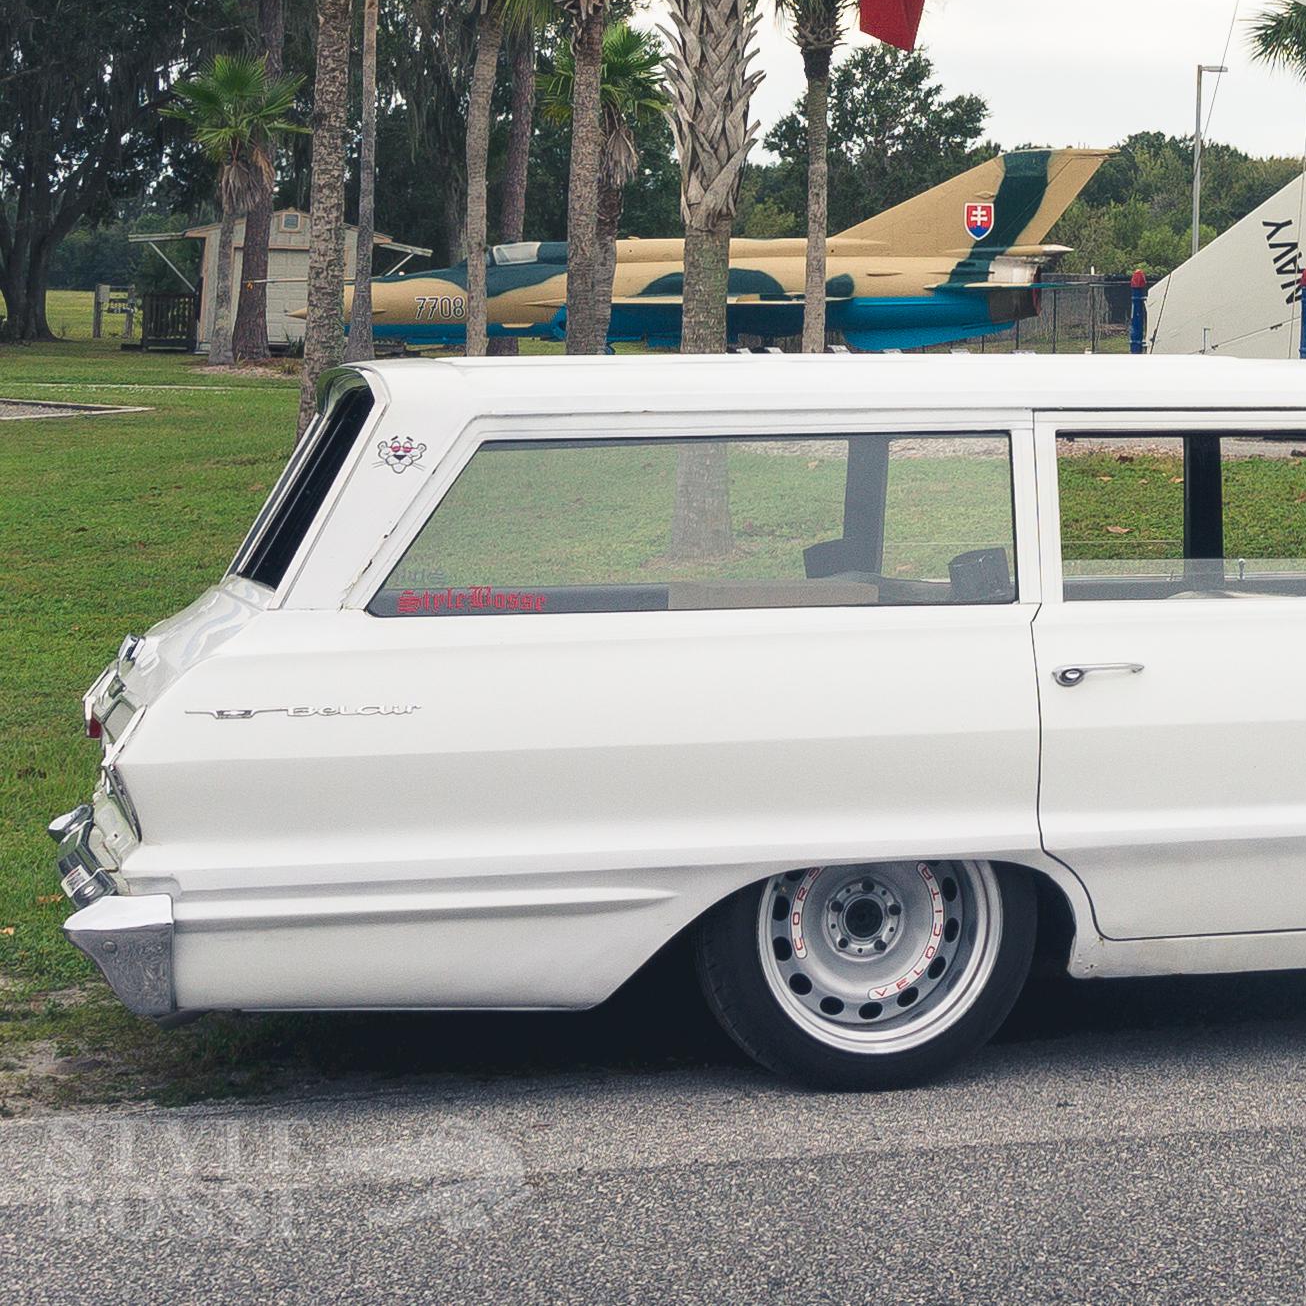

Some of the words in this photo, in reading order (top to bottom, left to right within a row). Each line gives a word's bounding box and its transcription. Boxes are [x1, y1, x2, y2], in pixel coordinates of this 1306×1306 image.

[1261, 218, 1306, 305] NAVY
[414, 295, 466, 321] 7708
[873, 865, 944, 998] VELOCITA
